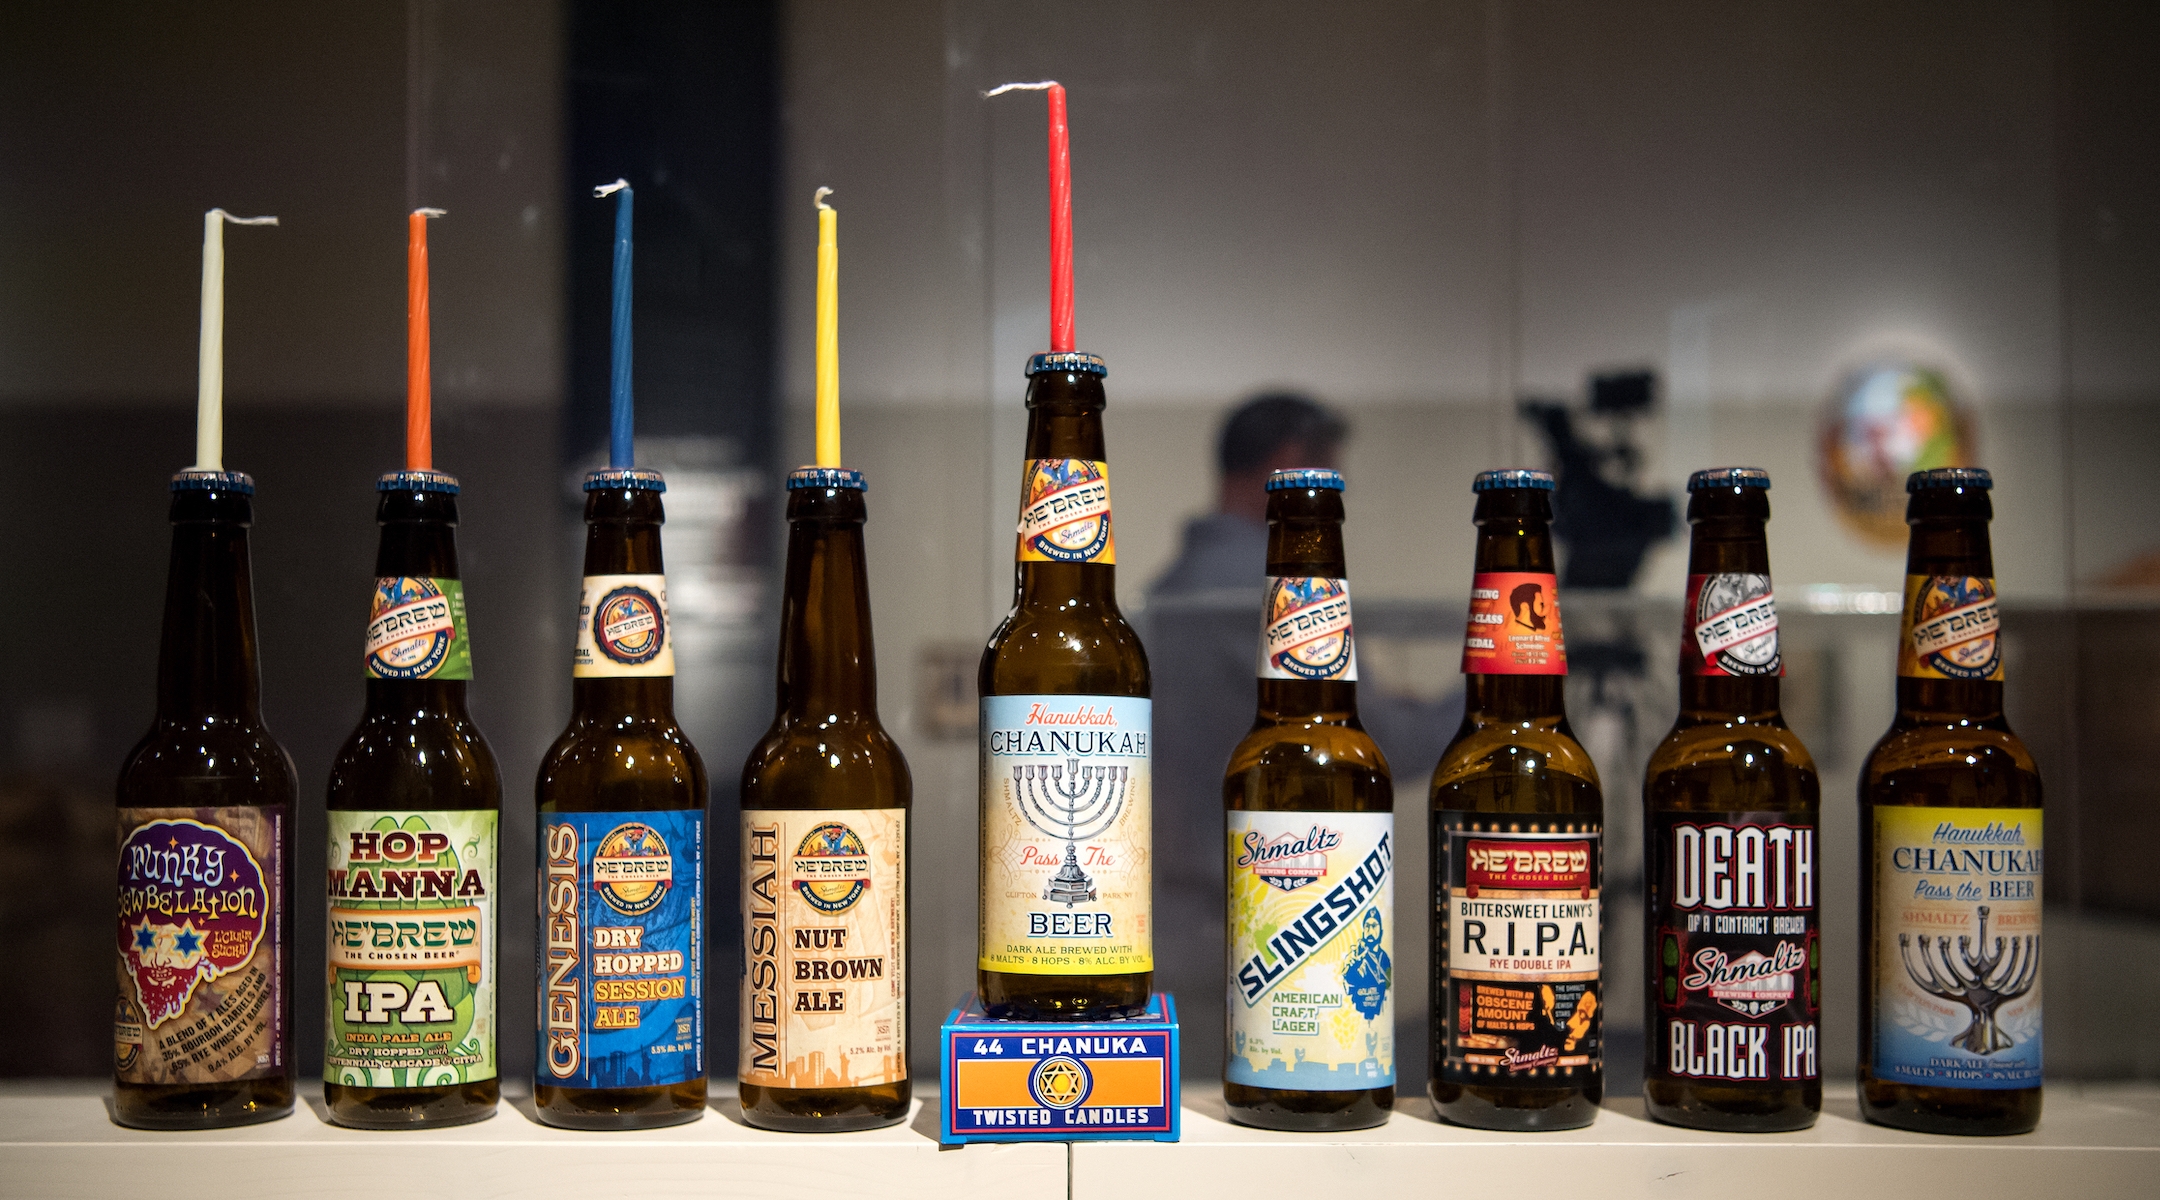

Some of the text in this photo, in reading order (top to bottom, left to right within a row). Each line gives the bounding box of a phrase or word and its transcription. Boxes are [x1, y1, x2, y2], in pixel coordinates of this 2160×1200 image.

[1023, 485, 1106, 529] HE'BREW
[1038, 540, 1070, 559] BREWED
[1084, 542, 1100, 557] NEW
[1098, 520, 1108, 542] YORK
[1267, 600, 1347, 645] HE'BREW
[372, 657, 399, 677] BREWED
[413, 659, 434, 675] NEW
[431, 636, 446, 660] YORK
[1283, 657, 1316, 676] BREWED
[1329, 657, 1345, 673] NEW
[1025, 703, 1118, 727] Hanukkah,
[990, 730, 1148, 757] CHANUKAH
[1003, 777, 1136, 827] SHMALTZ BREWING
[350, 831, 450, 863] HOP
[1020, 845, 1115, 866] Pass The
[1237, 825, 1340, 867] Shmaltz
[595, 859, 669, 874] HE'BREW
[794, 859, 868, 873] HE'BREW
[1469, 848, 1588, 873] HE'BREW
[1675, 825, 1813, 909] DEATH
[1255, 868, 1325, 877] BREWING COMPANY
[327, 868, 486, 899] MANNA
[1914, 879, 2035, 899] Pass the BEER
[603, 886, 624, 907] BREWED
[635, 900, 650, 909] NEW
[649, 885, 664, 902] YORK
[802, 886, 823, 907] BREWED
[833, 899, 848, 909] NEW
[848, 884, 862, 901] YORK
[1005, 891, 1037, 899] CLIFTON
[1238, 830, 1391, 1000] SLINGSHOT
[1461, 902, 1593, 919] BITTERSWEET LENNY'S
[1902, 911, 1970, 925] SHMALTZ
[331, 917, 477, 948] HE'BREW
[1027, 912, 1113, 938] BEER
[1687, 914, 1806, 935] OF A CONTRACT BREWER
[594, 927, 642, 948] DRY
[794, 928, 846, 949] NUT
[1463, 919, 1594, 957] R.I.P.A.
[345, 951, 456, 960] THE CHOSEN BEER
[548, 825, 579, 1078] GENESIS
[752, 829, 778, 1074] MESSIAH
[996, 954, 1025, 964] MALTS
[1041, 957, 1070, 965] HOPS
[1119, 955, 1130, 964] BY
[1006, 944, 1132, 954] DARK ALE BREWED WITH
[594, 952, 683, 975] HOPPED
[794, 957, 883, 980] BROWN
[1489, 958, 1571, 970] RYE DOUBLE IPA
[1683, 940, 1805, 990] Shmaltz
[594, 976, 685, 1001] SESSION
[1272, 993, 1339, 1005] AMERICAN
[1476, 985, 1534, 999] BREWED WITH AN
[1712, 990, 1792, 999] BREWING COMPANY
[159, 966, 259, 1050] A BLEND OF 7 ALES AGED IN
[344, 980, 455, 1023] IPA
[794, 991, 844, 1012] ALE
[1476, 995, 1533, 1010] OBSCENE
[181, 1024, 223, 1053] BOURBON
[221, 991, 256, 1028] BARRELS
[252, 972, 266, 992] AND
[191, 1047, 211, 1064] RYE
[210, 1019, 249, 1052] WHISKEY
[246, 982, 273, 1021] BARRELS
[594, 1007, 639, 1028] ALE
[1272, 1007, 1316, 1019] CRAFT
[1476, 1007, 1528, 1021] AMOUNT
[1272, 1020, 1316, 1032] LAGER
[1476, 1020, 1485, 1029] OF
[1486, 1021, 1508, 1030] MALTS
[1516, 1022, 1535, 1031] HOPS
[243, 1034, 255, 1047] BY
[345, 1031, 453, 1044] INDIA PALE ALE
[973, 1037, 1148, 1056] 44 CHANUKA
[348, 1042, 449, 1057] DRY HOPPED with
[1500, 1044, 1558, 1066] Shmaltz
[1670, 1020, 1817, 1079] BLACK IPA
[382, 1057, 441, 1069] CASCADE
[452, 1053, 484, 1065] CITRA
[1930, 1057, 1960, 1069] DARK
[1953, 1071, 1983, 1080] HOPS
[973, 1107, 1149, 1126] TWISTED CANDLES
